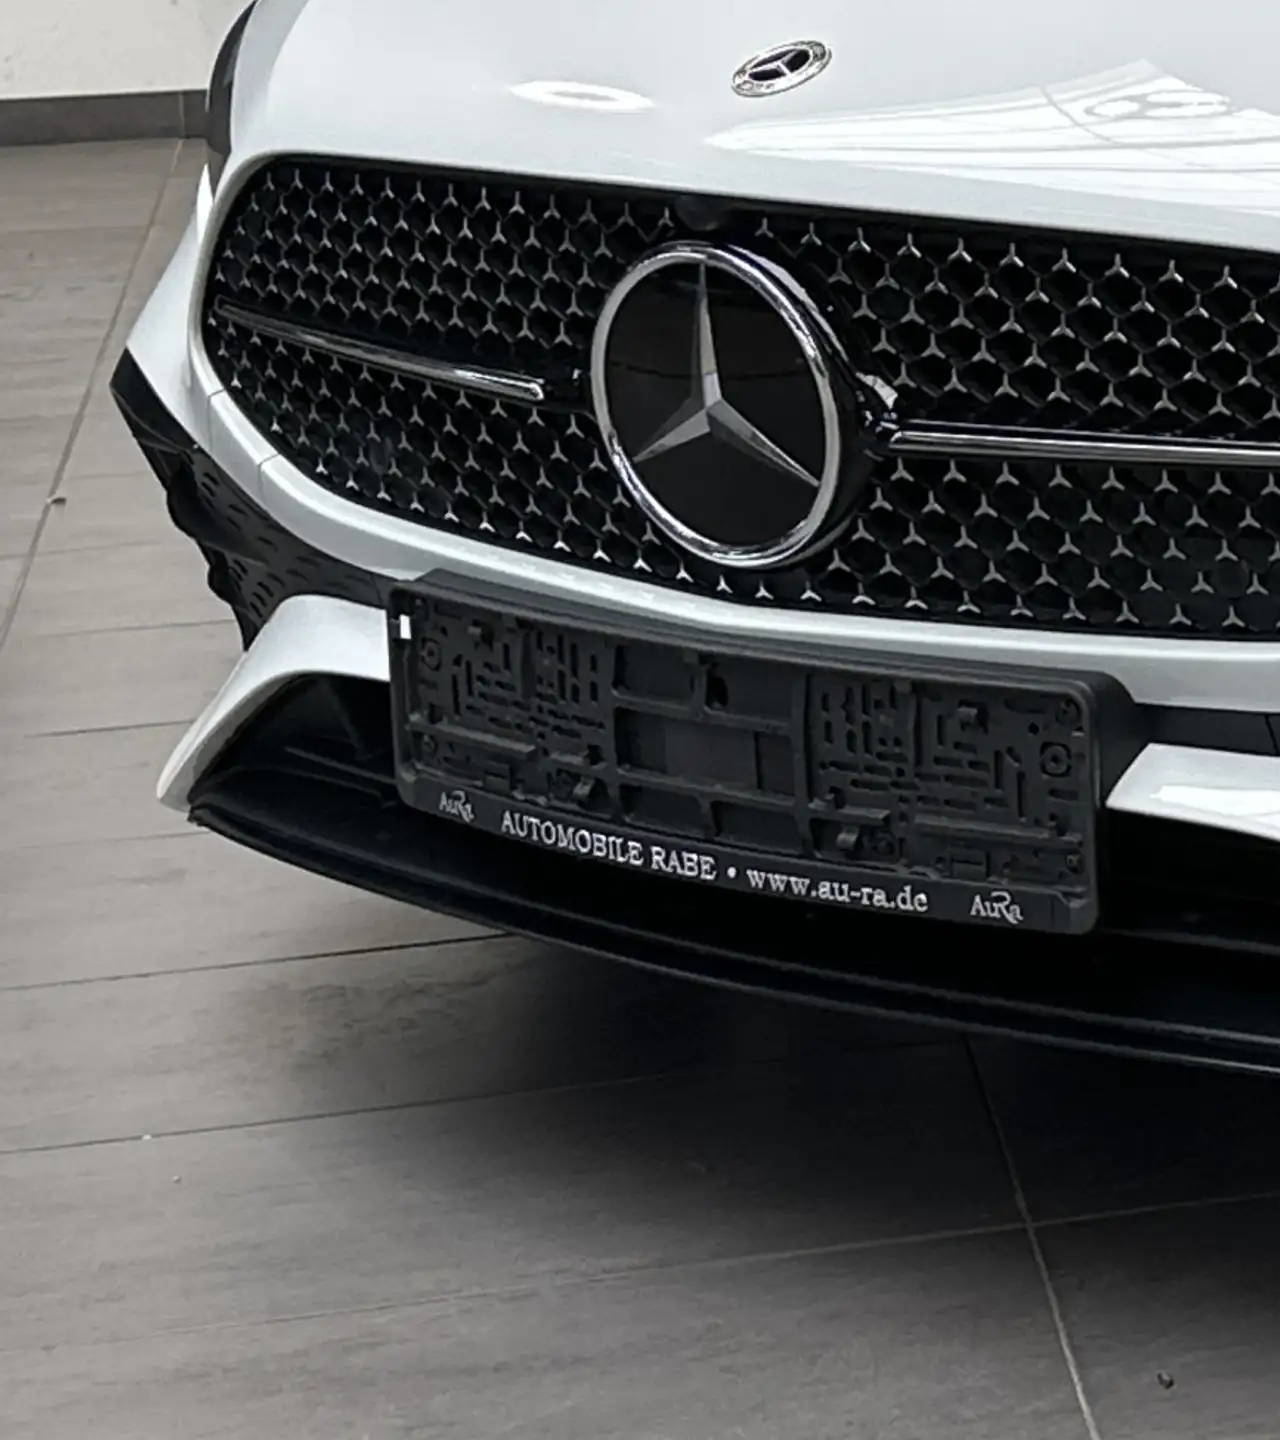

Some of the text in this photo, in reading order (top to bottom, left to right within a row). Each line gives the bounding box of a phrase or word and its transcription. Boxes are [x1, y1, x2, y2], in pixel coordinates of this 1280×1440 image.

[501, 809, 929, 912] AUTOMOBILE RABE www.au-ra.de
[968, 891, 1024, 925] AuRa
